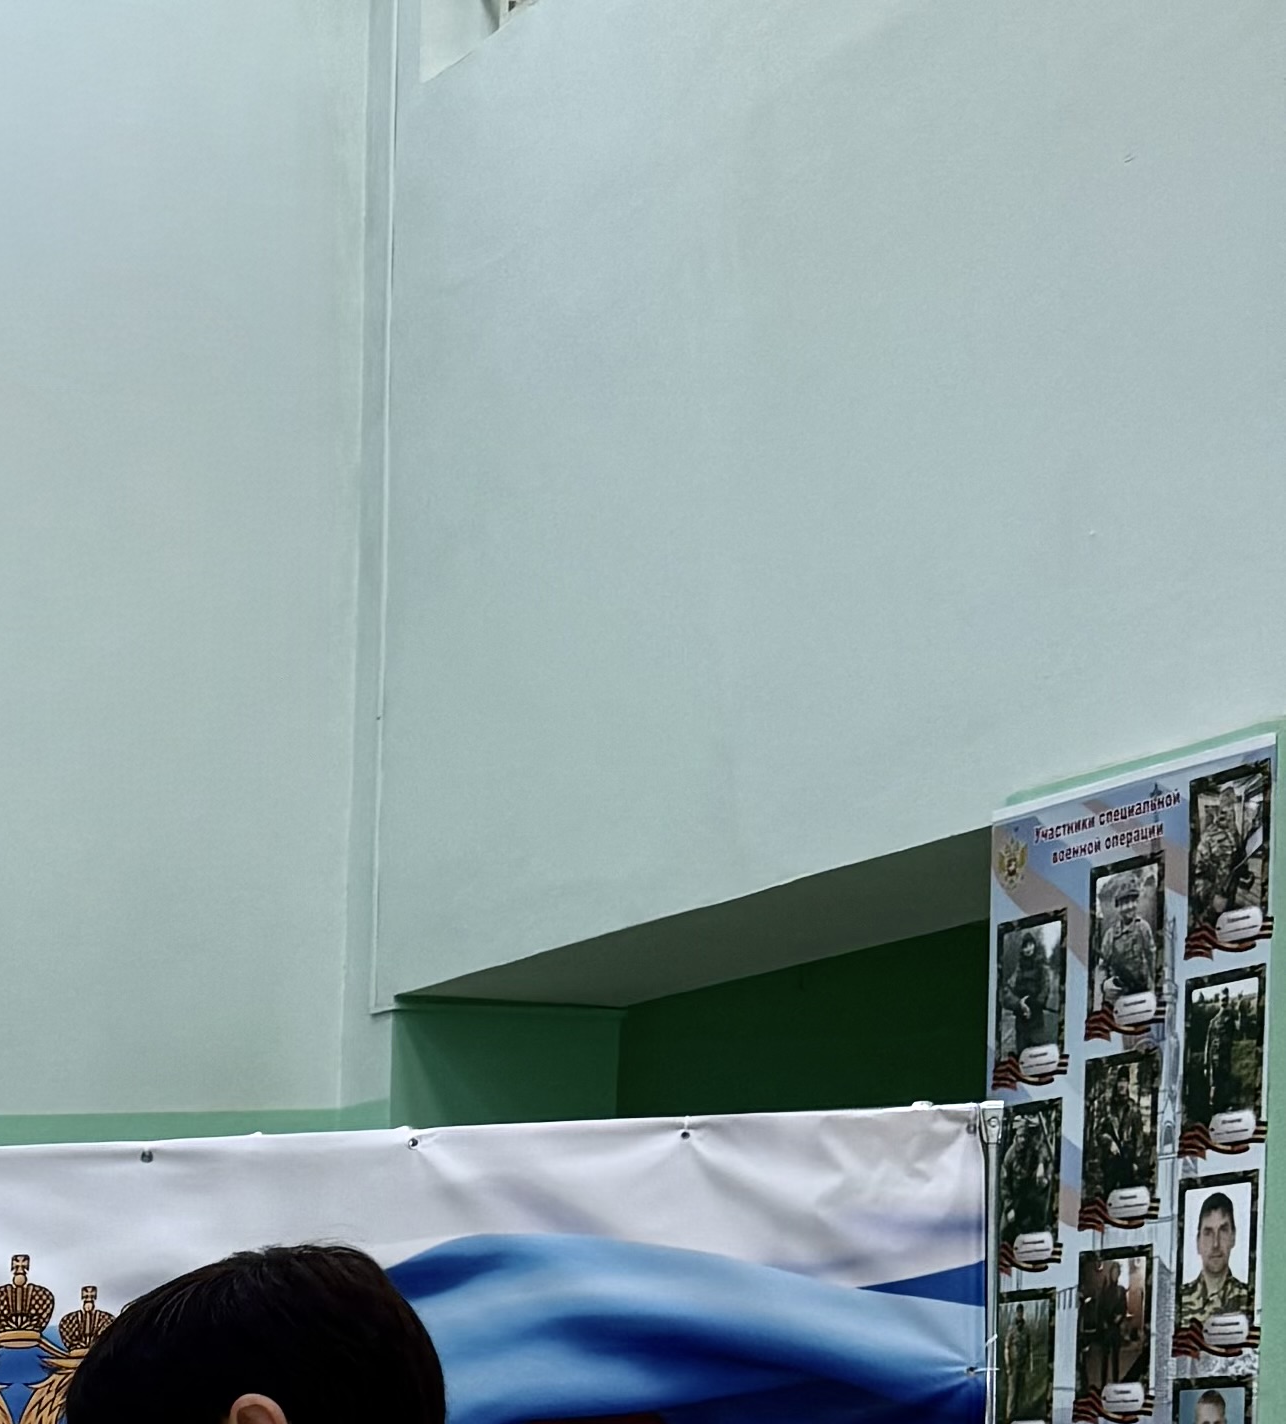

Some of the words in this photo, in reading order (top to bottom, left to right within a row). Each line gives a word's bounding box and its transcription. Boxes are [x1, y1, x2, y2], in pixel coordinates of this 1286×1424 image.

[1034, 815, 1095, 844] Участники
[1099, 788, 1181, 826] специальной
[1052, 837, 1102, 864] военной
[1104, 823, 1164, 849] операции
